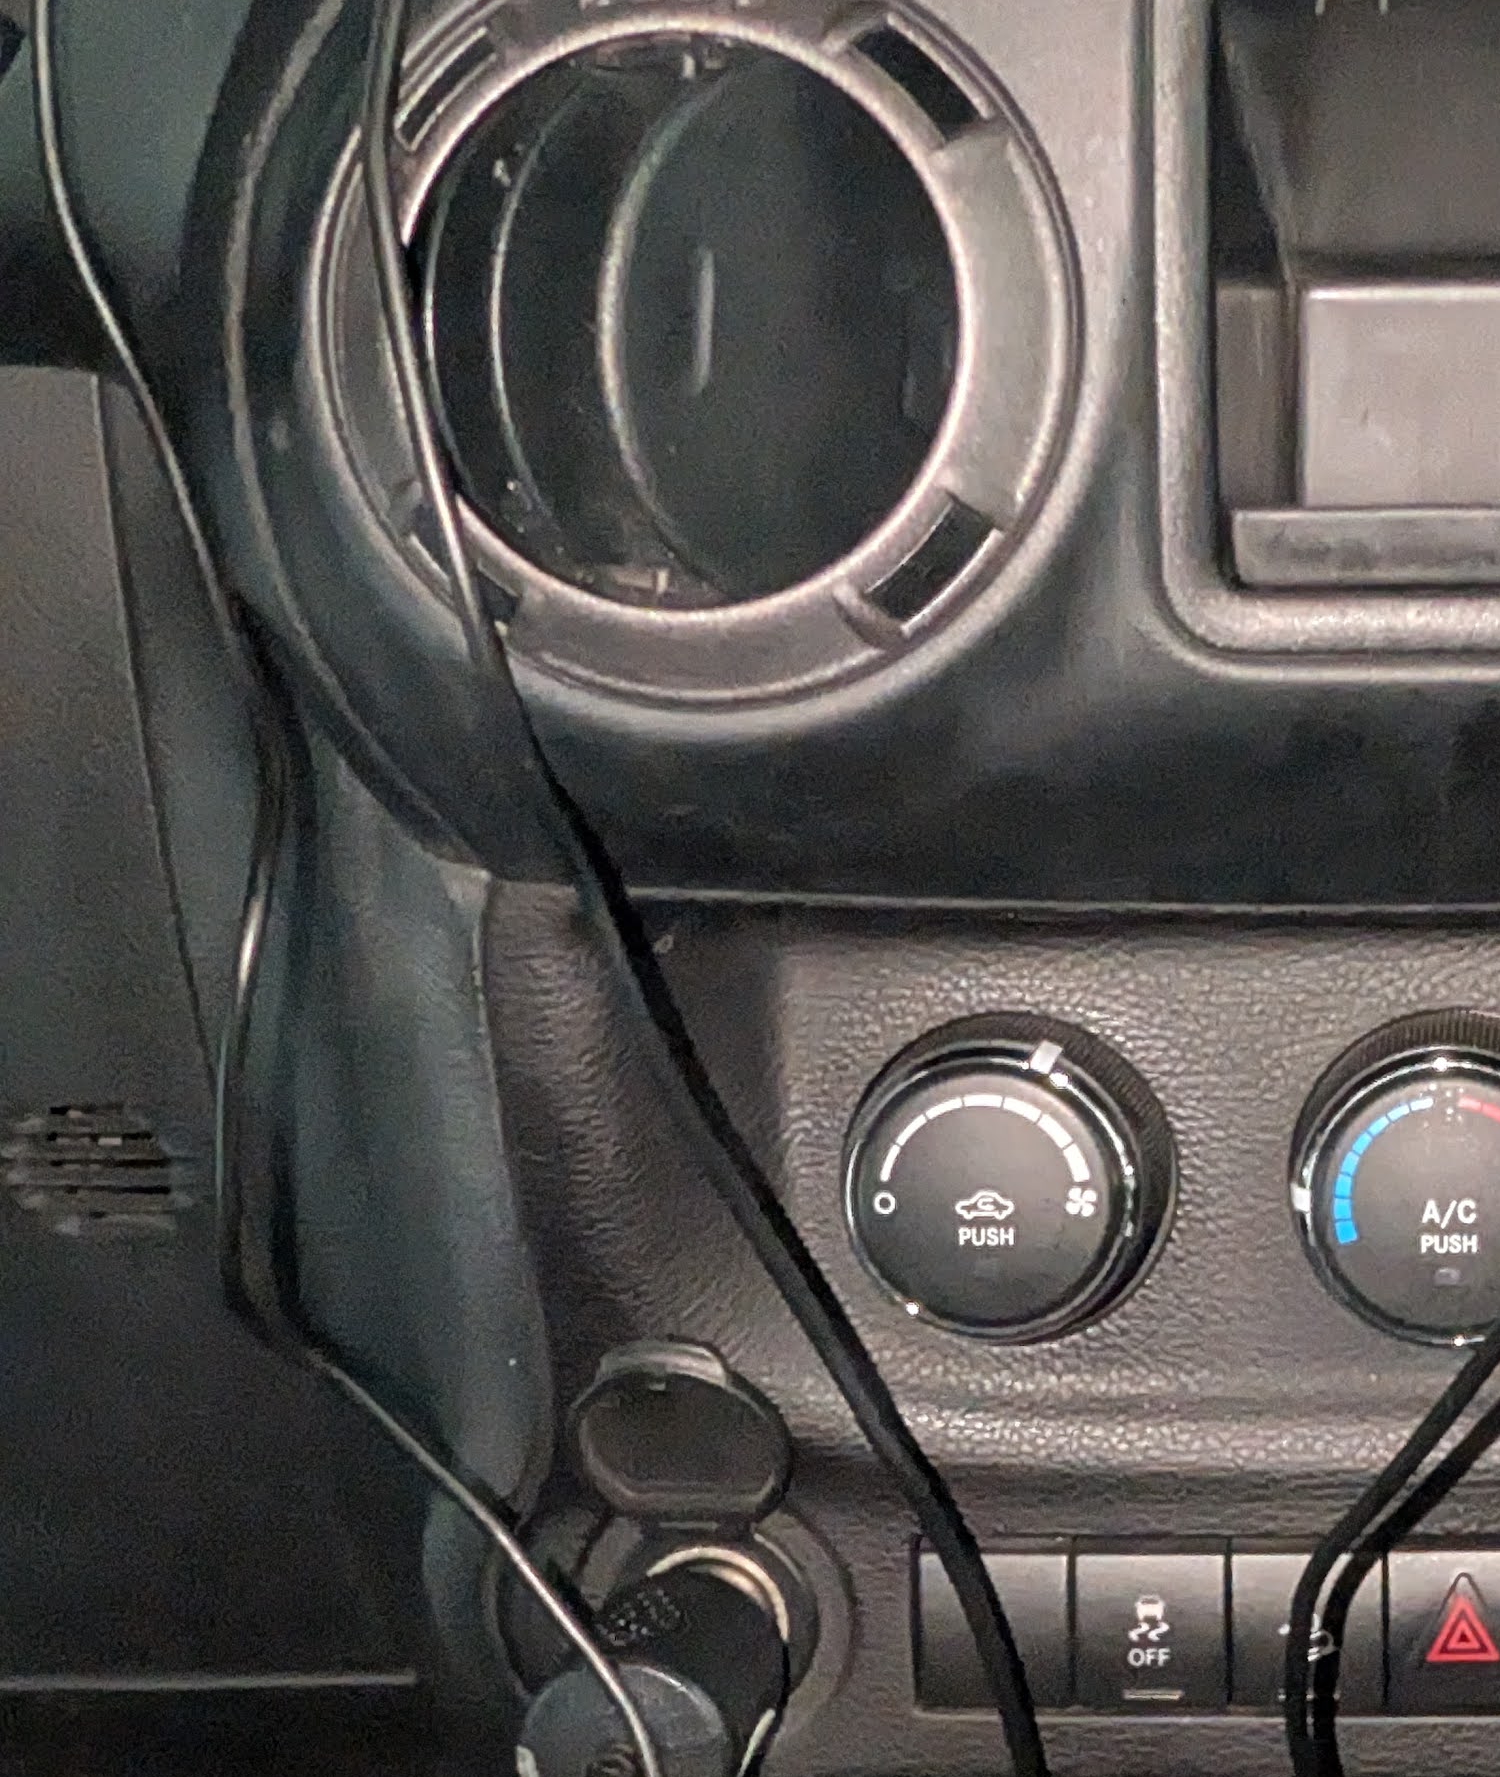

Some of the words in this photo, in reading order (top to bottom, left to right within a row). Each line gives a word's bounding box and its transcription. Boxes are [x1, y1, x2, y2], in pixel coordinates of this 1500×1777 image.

[1421, 1198, 1477, 1225] A/C
[957, 1225, 1016, 1248] PUSH
[1420, 1230, 1479, 1254] PUSH
[1127, 1647, 1171, 1668] OFF
